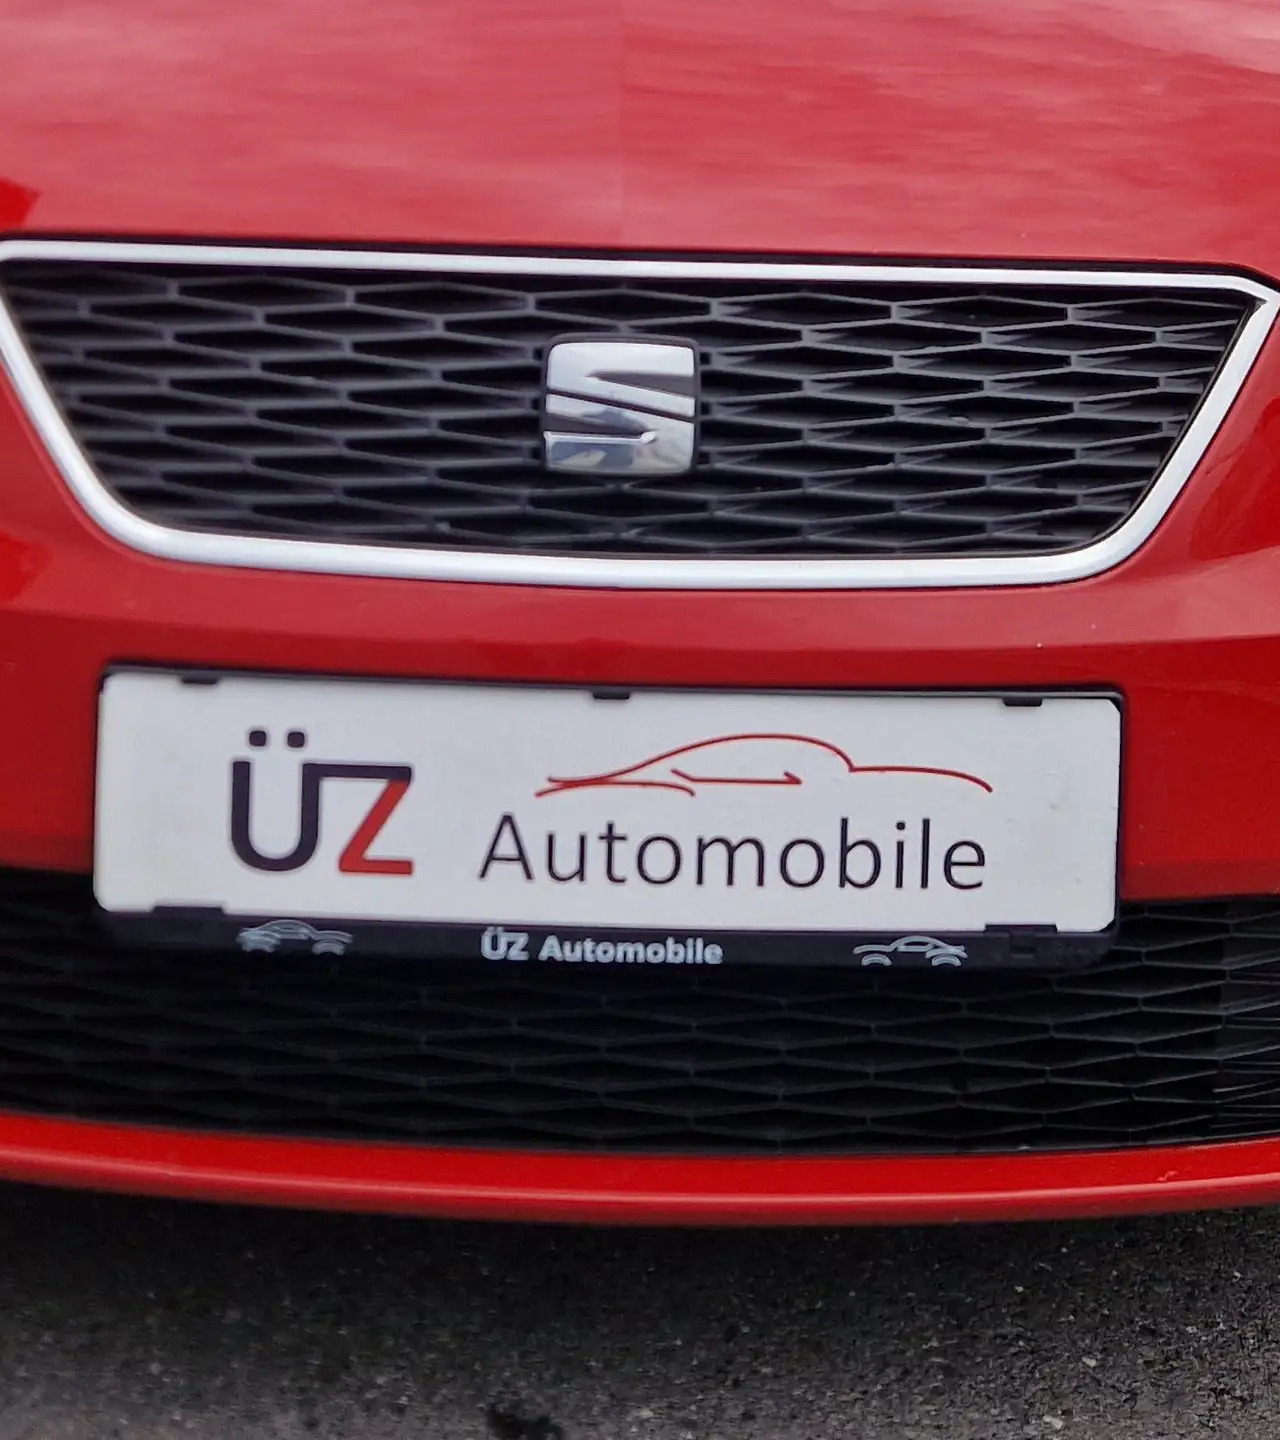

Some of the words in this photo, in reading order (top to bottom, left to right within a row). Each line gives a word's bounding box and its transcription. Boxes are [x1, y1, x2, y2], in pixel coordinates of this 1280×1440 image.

[230, 728, 414, 876] ÜZ
[478, 811, 987, 891] Automobile
[480, 925, 530, 961] ÜZ
[537, 933, 725, 965] Automobile
